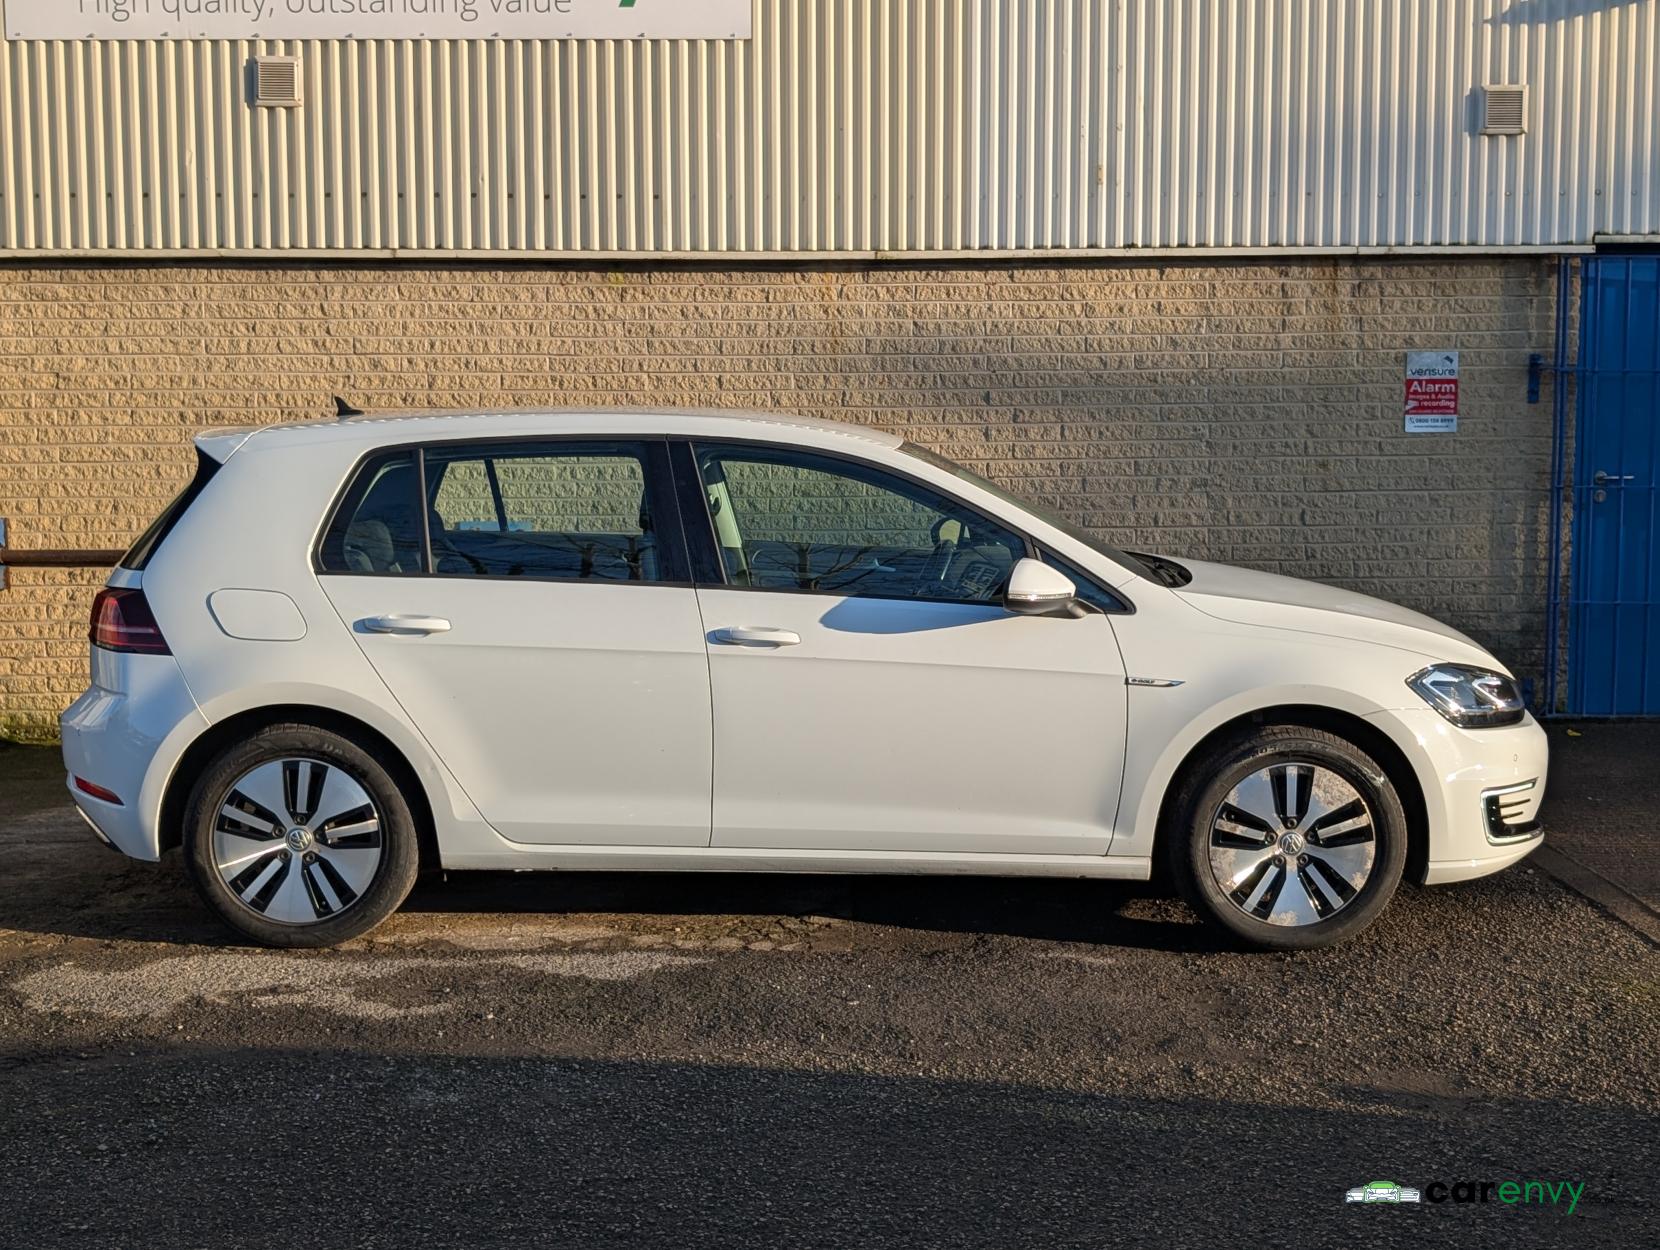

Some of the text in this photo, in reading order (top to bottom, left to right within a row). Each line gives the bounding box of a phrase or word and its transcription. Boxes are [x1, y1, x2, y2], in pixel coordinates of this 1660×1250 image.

[1410, 367, 1456, 376] verisure
[1409, 381, 1456, 393] Alarm
[1420, 400, 1455, 408] recording
